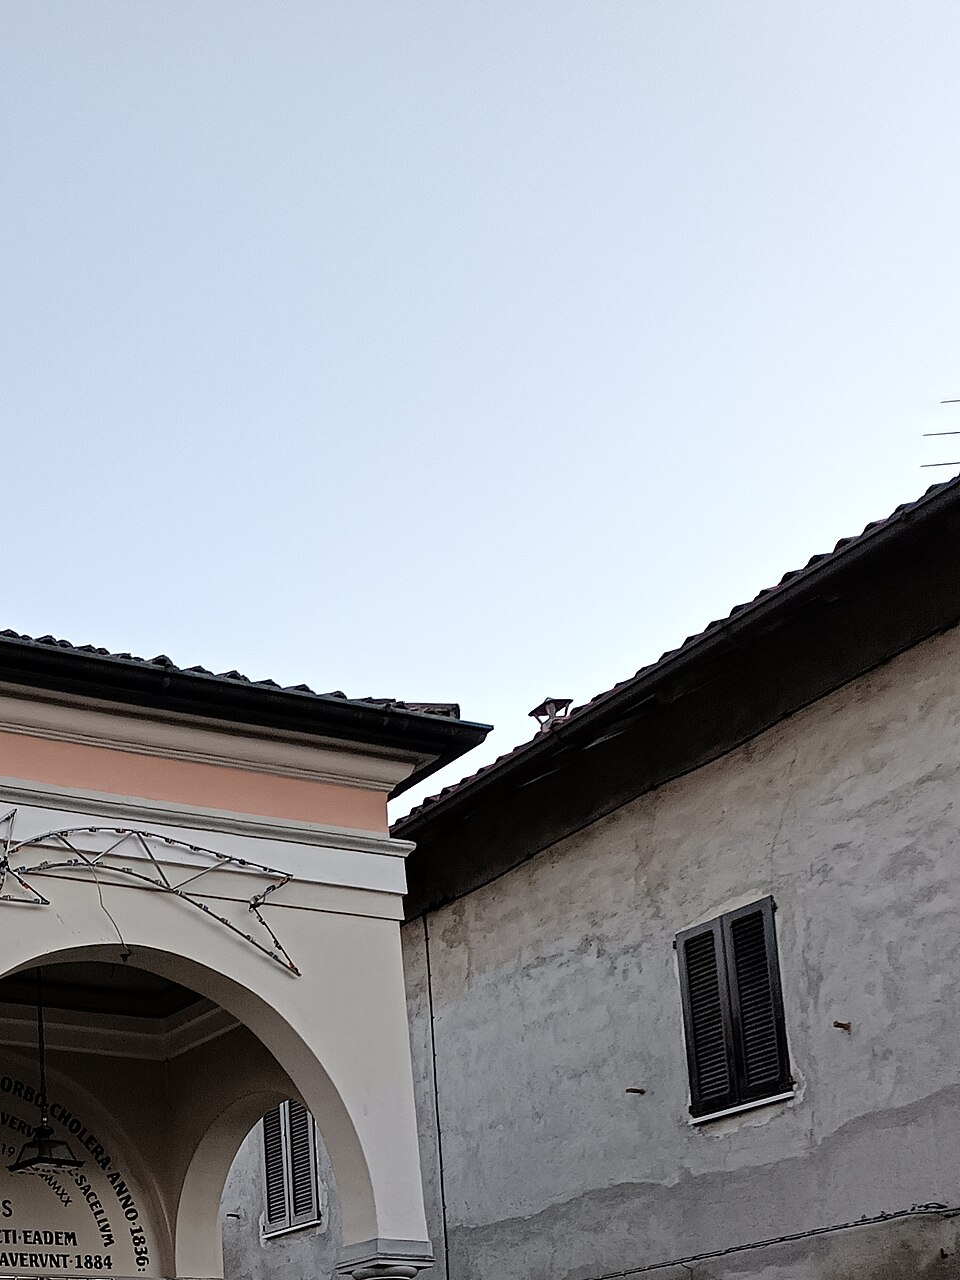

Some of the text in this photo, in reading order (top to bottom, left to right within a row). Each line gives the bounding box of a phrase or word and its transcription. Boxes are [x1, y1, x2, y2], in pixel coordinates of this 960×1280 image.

[49, 1103, 112, 1171] CHOLERA
[106, 1171, 139, 1222] ANNO
[22, 1230, 78, 1247] EADEM
[74, 1254, 113, 1270] 1884
